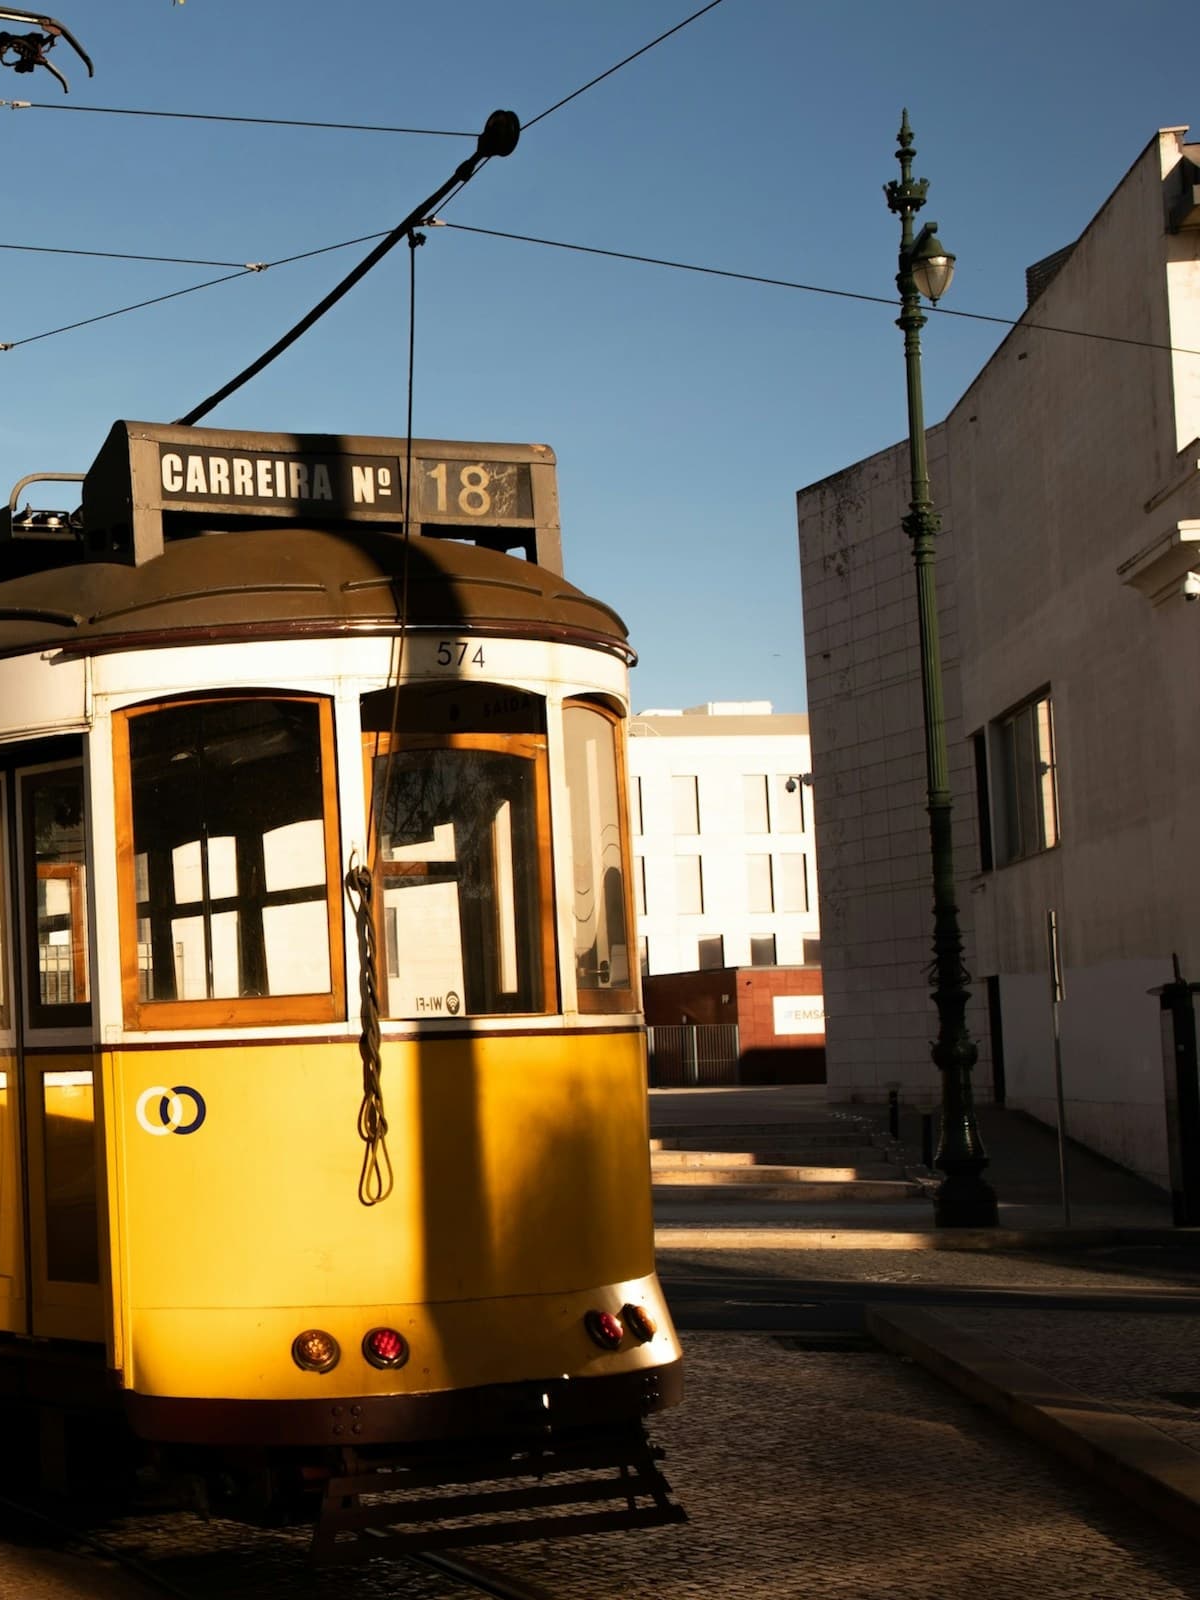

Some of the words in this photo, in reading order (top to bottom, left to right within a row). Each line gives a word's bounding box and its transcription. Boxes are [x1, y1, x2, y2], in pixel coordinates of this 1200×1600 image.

[161, 453, 333, 500] CARREIRA
[426, 463, 492, 516] 18
[437, 641, 486, 668] 574
